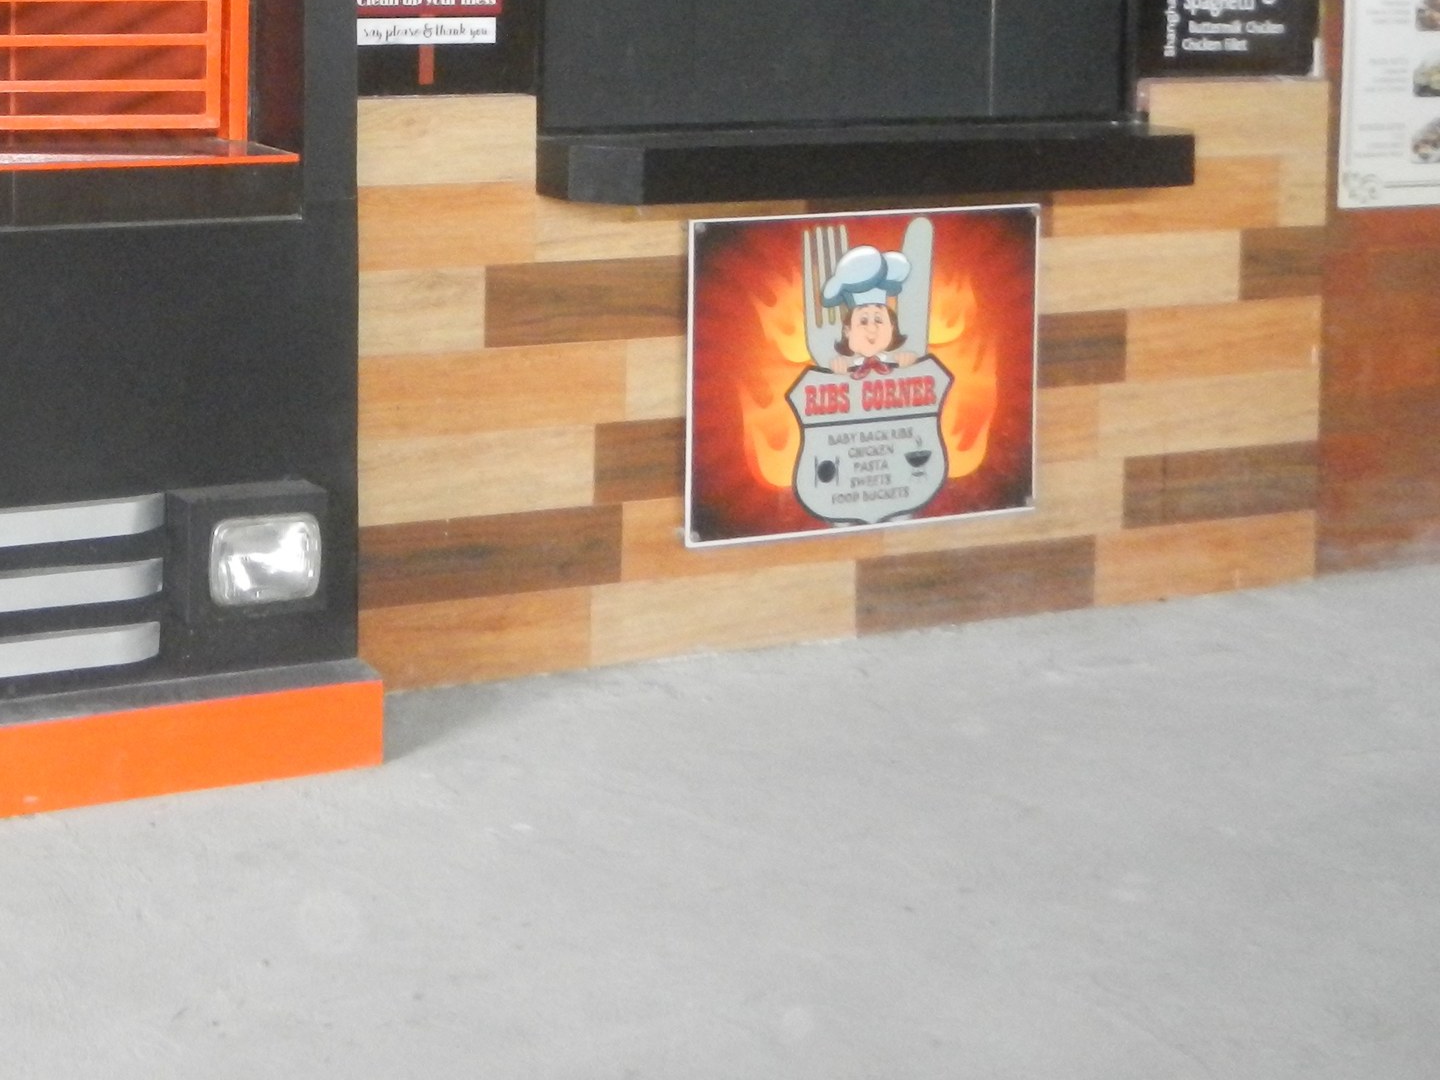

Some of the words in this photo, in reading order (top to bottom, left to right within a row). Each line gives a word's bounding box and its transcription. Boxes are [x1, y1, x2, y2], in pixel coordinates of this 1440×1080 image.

[363, 28, 383, 39] say
[385, 25, 420, 41] please
[434, 23, 466, 37] thank
[469, 28, 488, 39] you
[804, 382, 851, 417] RIBS
[861, 375, 937, 411] CORNER
[828, 431, 858, 447] BABY
[859, 429, 890, 444] BACK
[890, 426, 914, 441] RIBS
[847, 444, 894, 458] CHICKEN
[853, 458, 889, 472] PASTA
[850, 474, 892, 489] SWEETS
[831, 490, 860, 505] FOOD
[862, 485, 910, 501] BUCKETS
